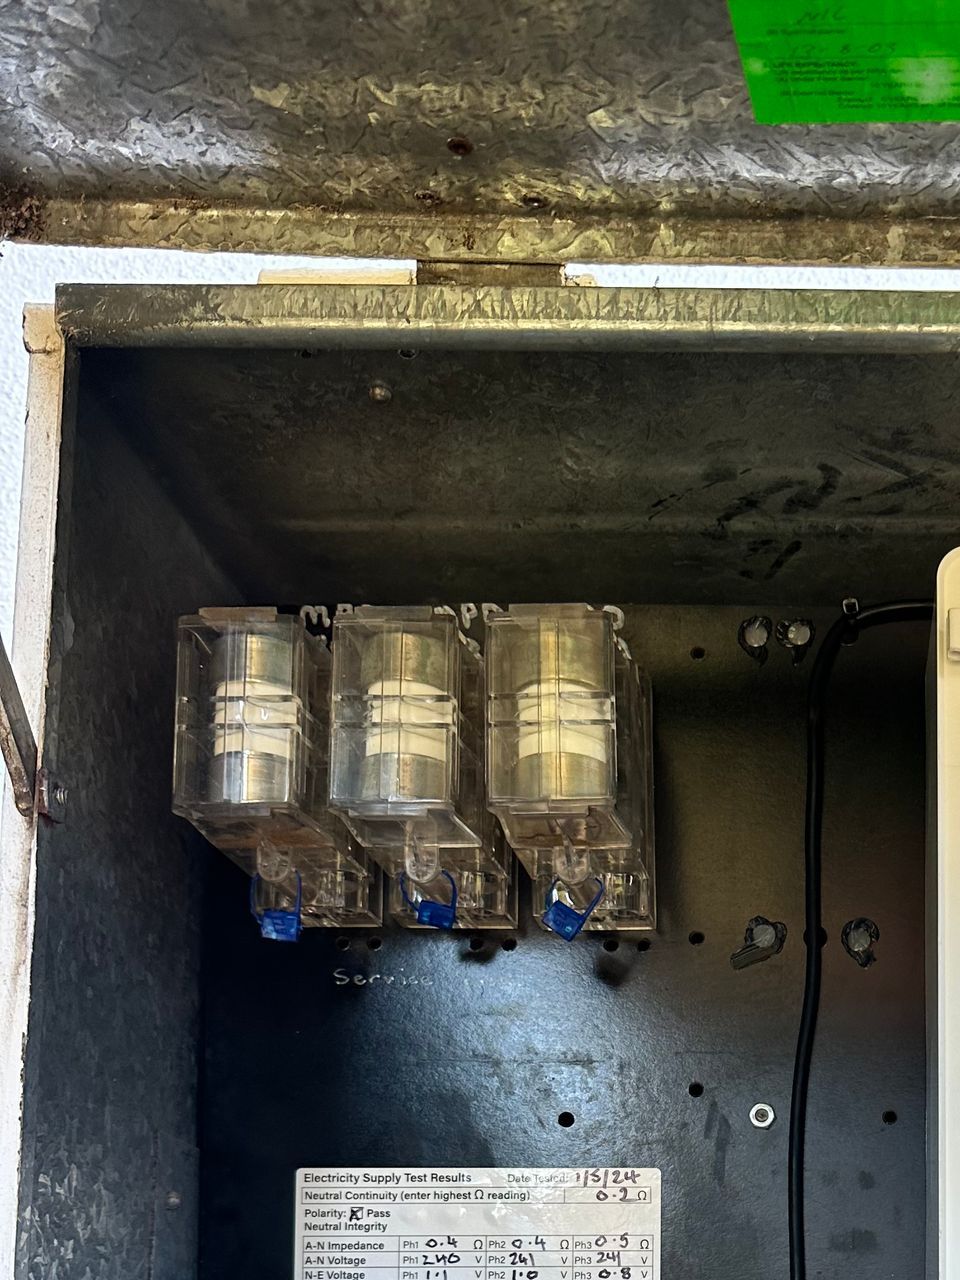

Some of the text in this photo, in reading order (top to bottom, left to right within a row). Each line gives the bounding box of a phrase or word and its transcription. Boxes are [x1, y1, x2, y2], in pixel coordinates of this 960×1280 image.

[304, 1173, 472, 1184] Electricity Supply Test Results
[508, 1174, 530, 1182] Date
[305, 1189, 530, 1202] Neutral Continuity (enter highest reading)
[305, 1209, 391, 1220] Polarity: Pass
[305, 1223, 387, 1232] Neutral Integrity
[306, 1241, 384, 1252] A-N Impedance
[304, 1256, 366, 1266] A-N Voltage
[304, 1271, 366, 1280] N-E Voltage
